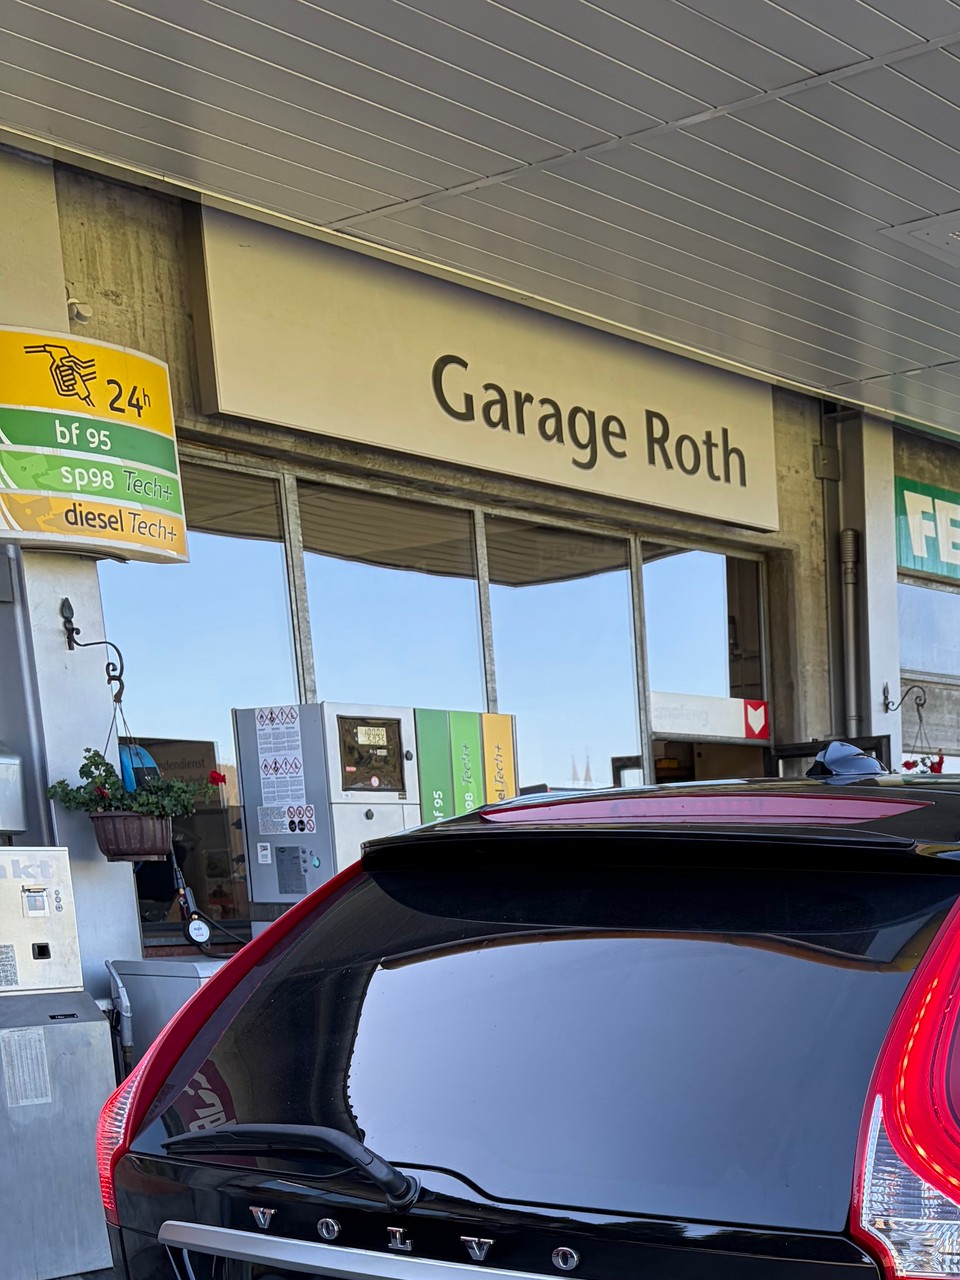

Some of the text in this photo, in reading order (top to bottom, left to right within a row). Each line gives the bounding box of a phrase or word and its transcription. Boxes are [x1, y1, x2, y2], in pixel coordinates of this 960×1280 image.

[106, 378, 151, 418] 24h
[55, 420, 112, 451] bf 95
[431, 354, 747, 487] Garage Roth
[60, 466, 173, 501] sp98 Tech+
[64, 503, 177, 542] diesel Tech+
[433, 790, 444, 807] 95
[249, 1206, 581, 1271] VOLVO
